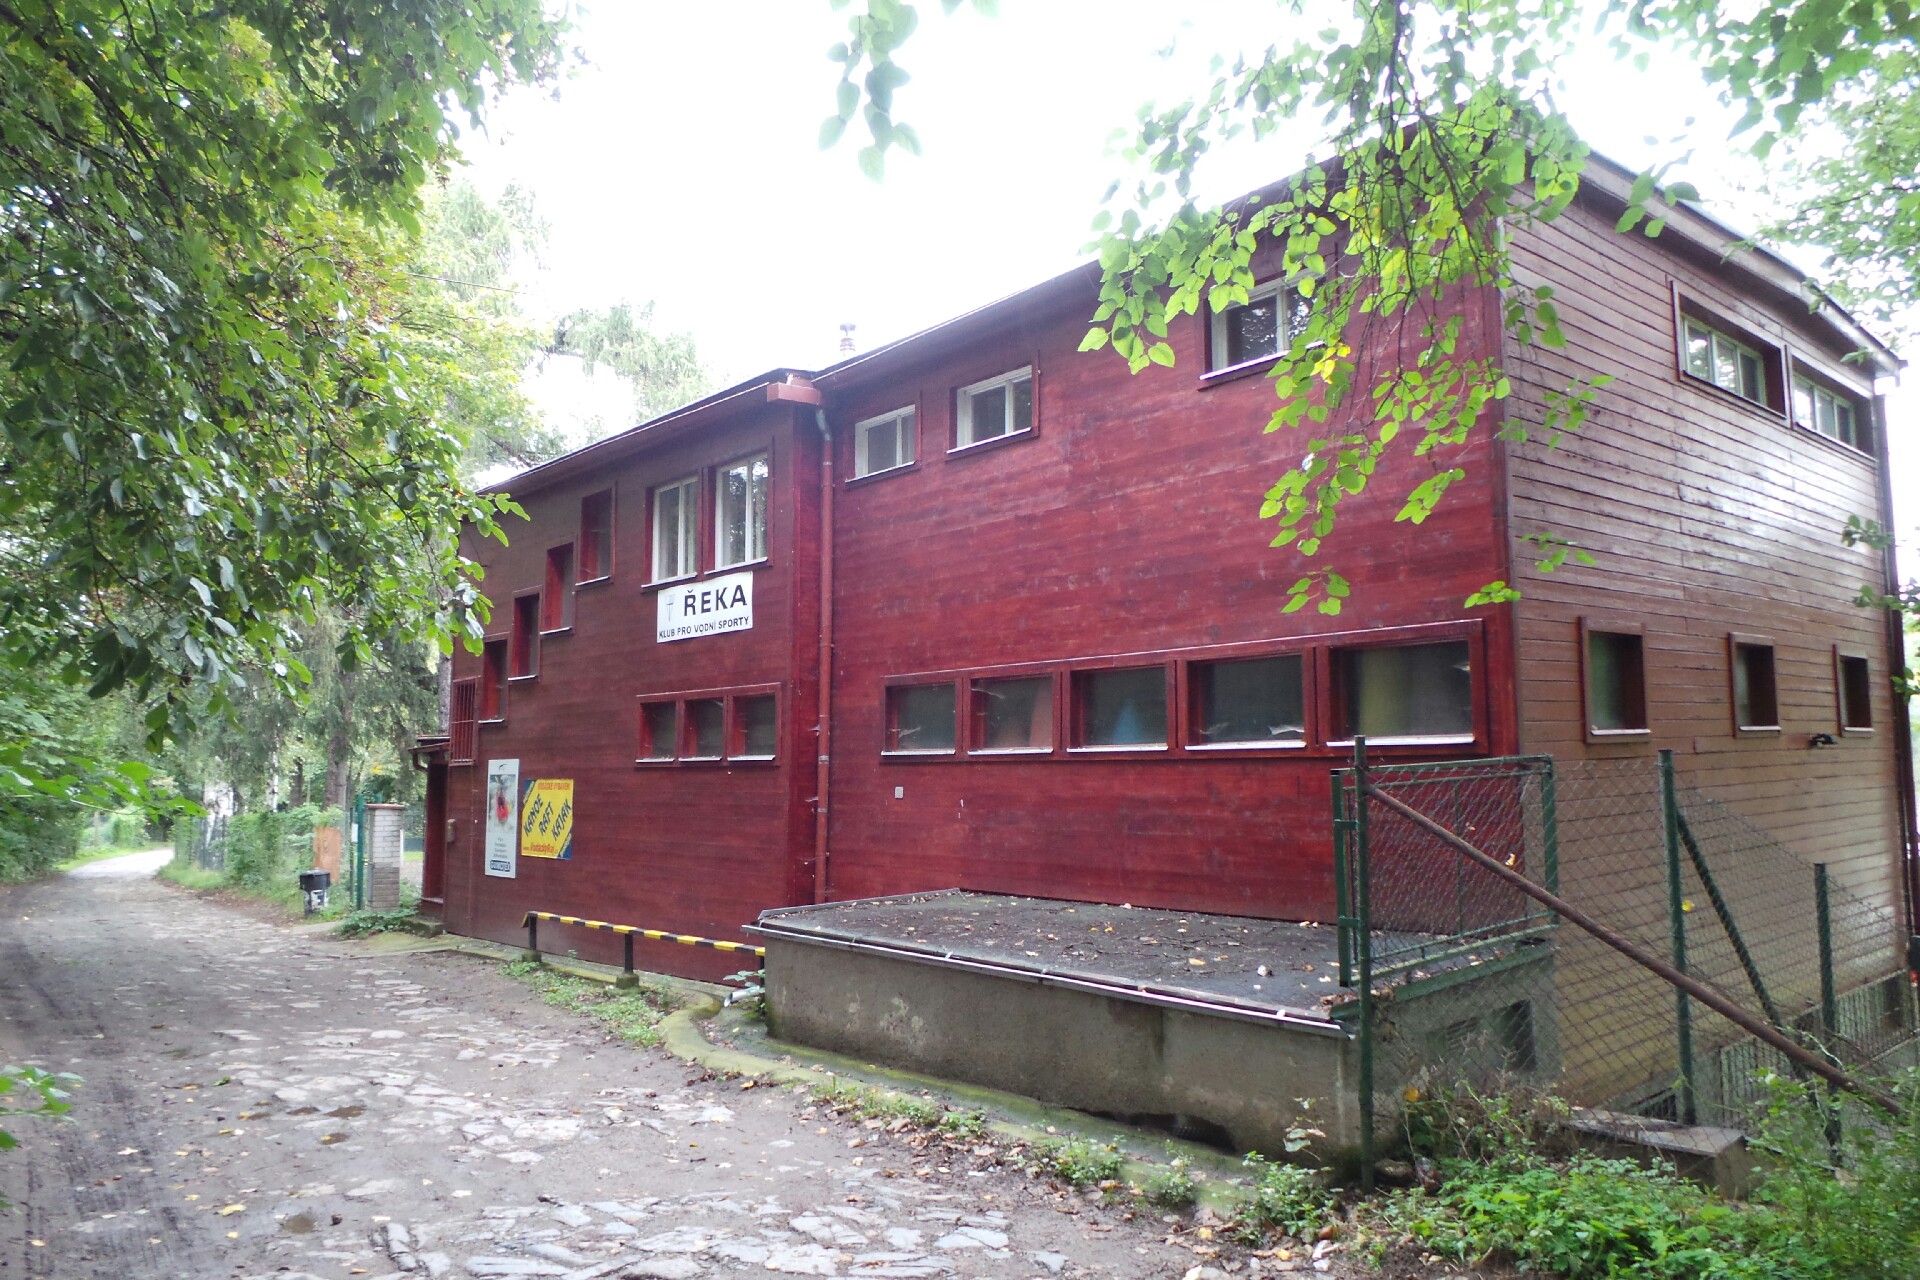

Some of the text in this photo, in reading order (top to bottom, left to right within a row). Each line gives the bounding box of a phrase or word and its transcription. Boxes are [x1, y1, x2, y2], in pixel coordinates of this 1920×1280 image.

[684, 584, 747, 617] ŘEKA
[658, 616, 750, 640] KLUB PRO VODNÍ SPORTY
[523, 793, 544, 837] KANOE
[538, 801, 554, 836] RAFT
[551, 798, 572, 841] KAJAK
